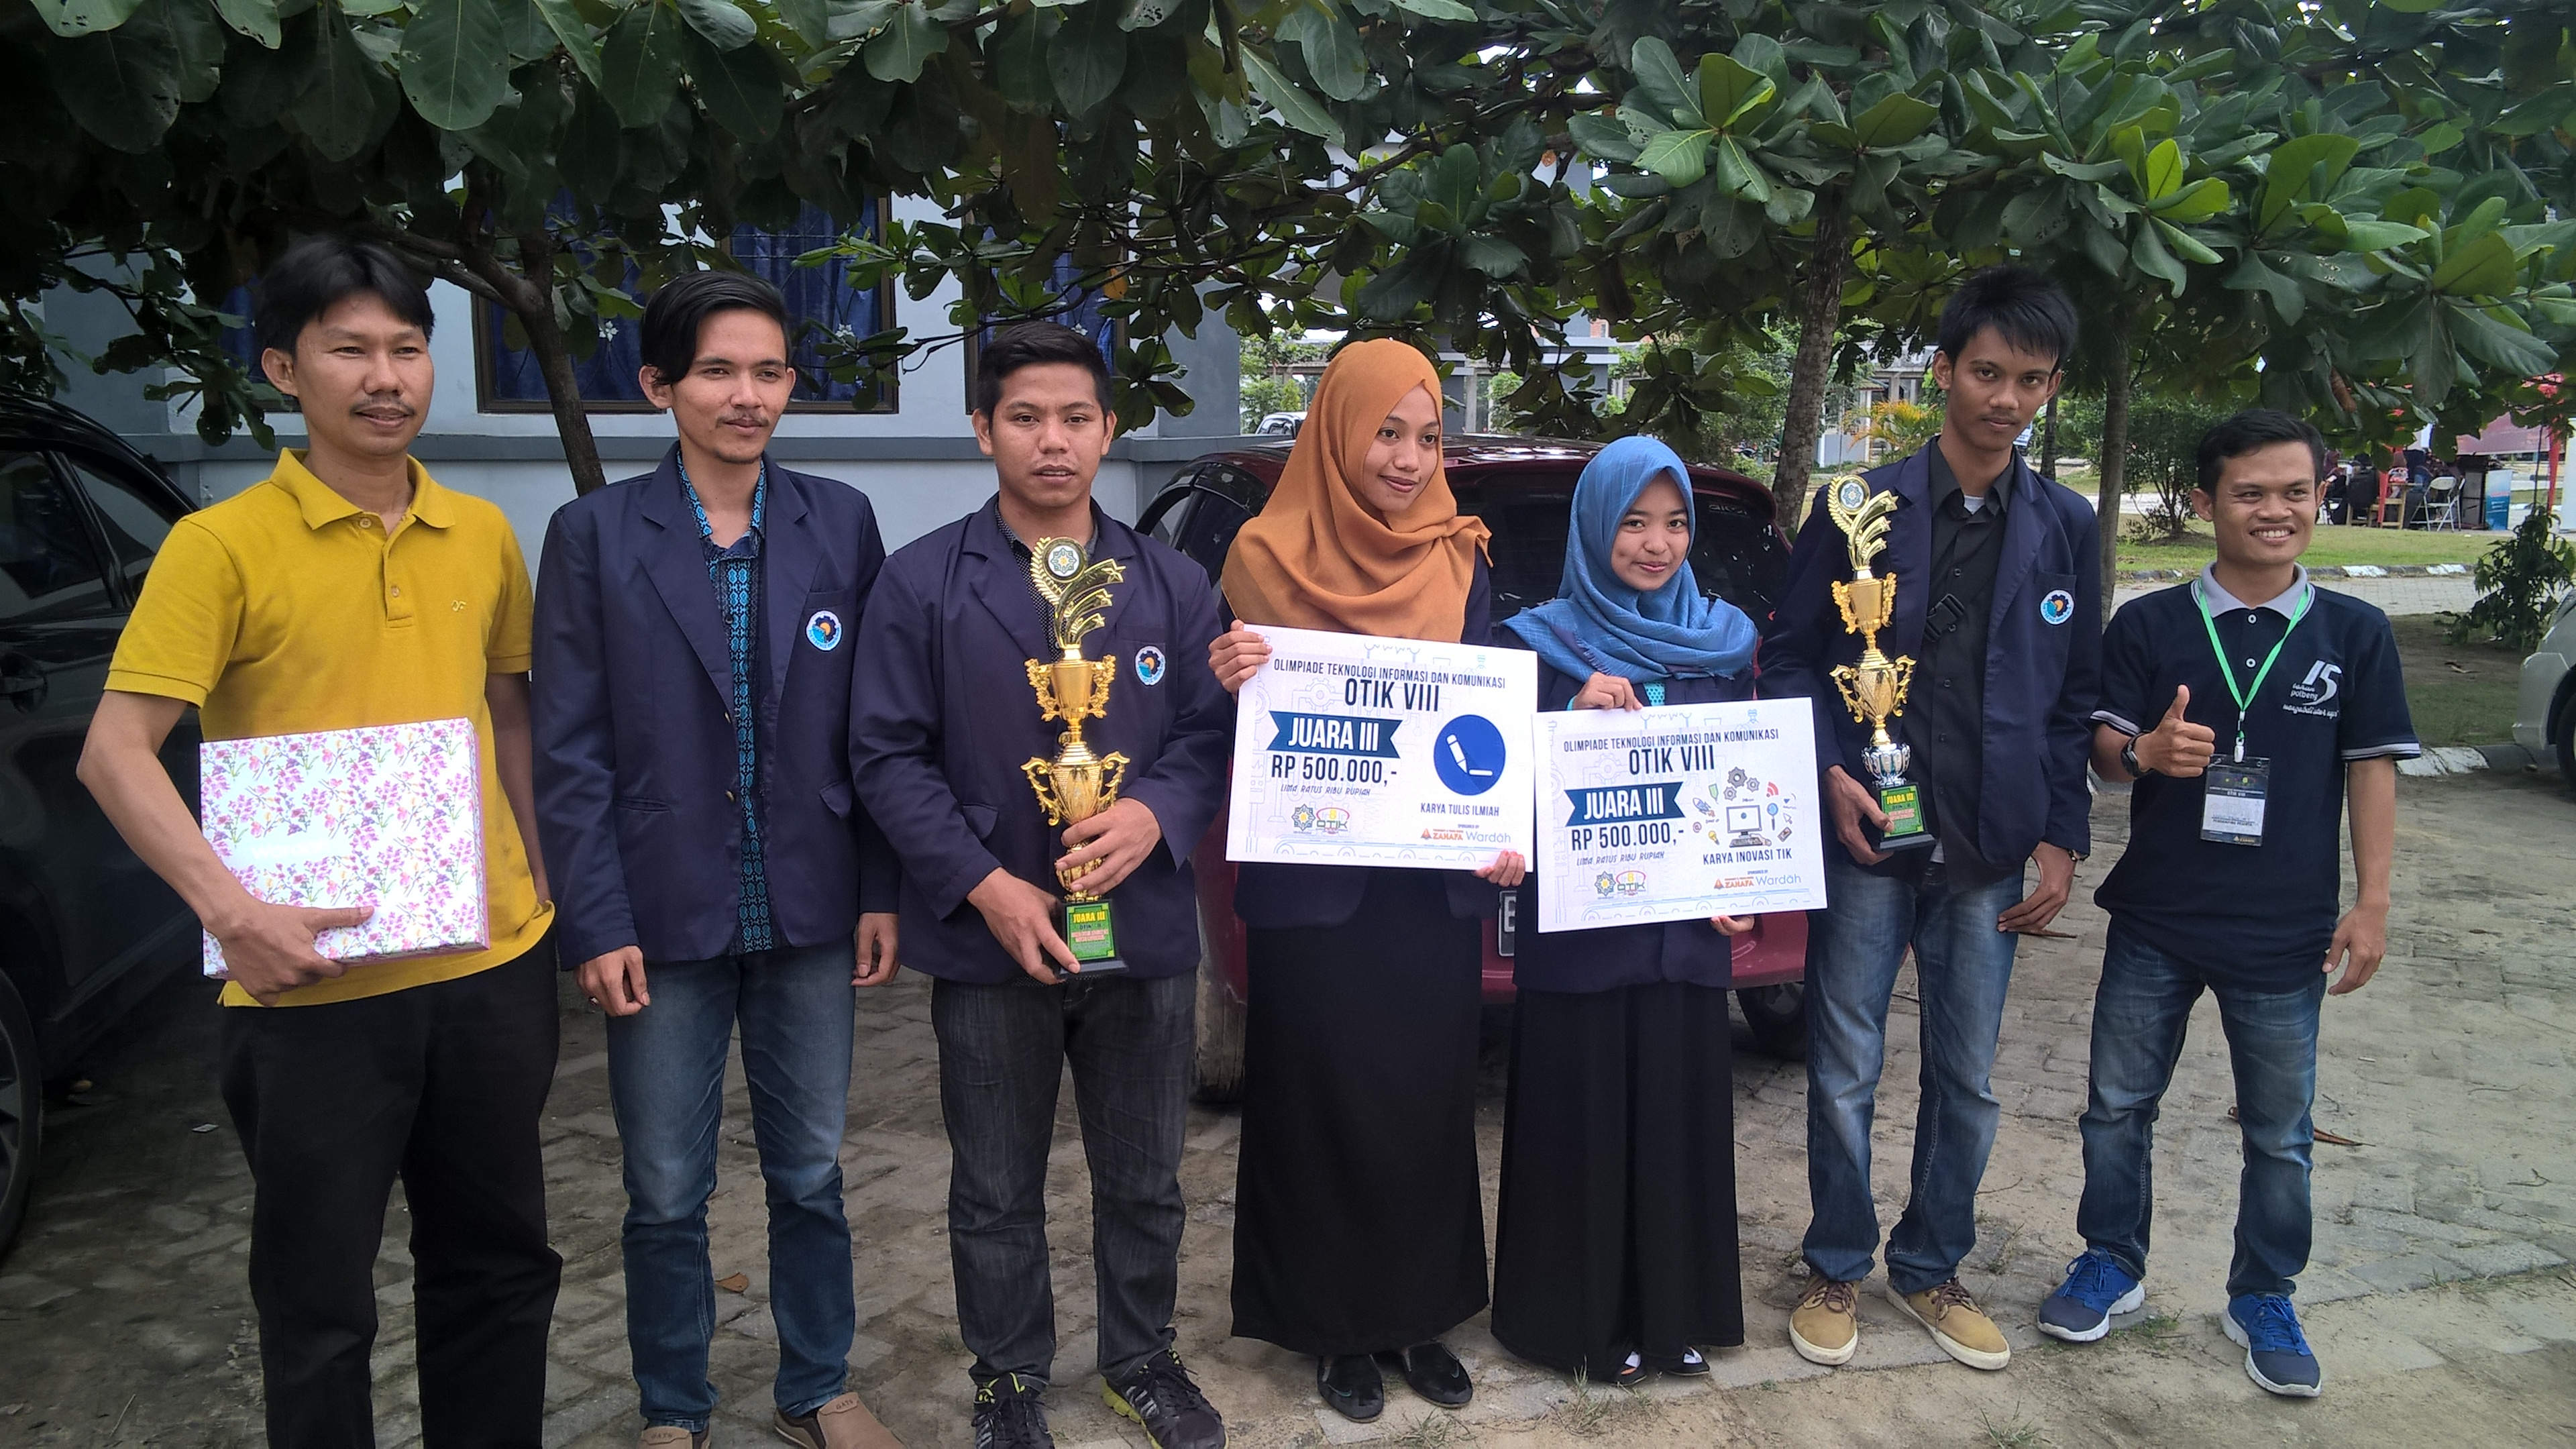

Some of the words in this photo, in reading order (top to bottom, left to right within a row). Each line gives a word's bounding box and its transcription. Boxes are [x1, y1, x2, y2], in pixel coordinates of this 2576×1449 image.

[1274, 658, 1324, 675] OLIMPIADE
[1327, 663, 1377, 679] TEKNOLOGI
[1379, 667, 1428, 683] INFORMASI
[1431, 672, 1450, 684] DAN
[1452, 673, 1506, 689] KOMUNIKASI
[2302, 659, 2343, 705] 15
[1344, 678, 1395, 709] OTIK
[1403, 682, 1440, 712] VIII
[1287, 716, 1354, 751] JUARA
[1358, 721, 1380, 752] III
[1563, 739, 1609, 753] OLIMPIADE
[1611, 735, 1655, 749] TEKNOLOGI
[1657, 733, 1702, 746] INFORMASI
[1704, 731, 1721, 743] DAN
[1723, 728, 1780, 743] KOMUNIKASI
[1629, 747, 1674, 775] OTIK
[1680, 744, 1715, 771] VIII
[1271, 754, 1296, 779] RP
[1302, 756, 1397, 788] 500.000,-
[1280, 784, 1299, 792] LIMA
[1300, 785, 1323, 794] RATUS
[1325, 786, 1342, 795] RIBU
[1344, 788, 1371, 796] RUPIAH
[1420, 802, 1446, 814] KARYA
[1448, 804, 1470, 816] TULIS
[1472, 804, 1500, 817] ILMIAH
[1583, 788, 1643, 820] JUARA
[1646, 787, 1664, 816] III
[1316, 820, 1348, 829] OTIK
[1466, 830, 1511, 843] Wardah
[1572, 828, 1593, 851] RP
[1599, 822, 1684, 849] 500.000,-
[1576, 857, 1593, 866] LIMA
[1596, 855, 1617, 865] RATUS
[1620, 853, 1637, 862] RIBU
[1639, 851, 1665, 861] RUPIAH
[1703, 852, 1733, 865] KARYA
[1735, 849, 1774, 863] INOVASI
[1776, 847, 1792, 860] TIK
[1617, 881, 1646, 892] OTIK
[1755, 873, 1802, 886] Wardah
[1073, 912, 1095, 923] JUARA
